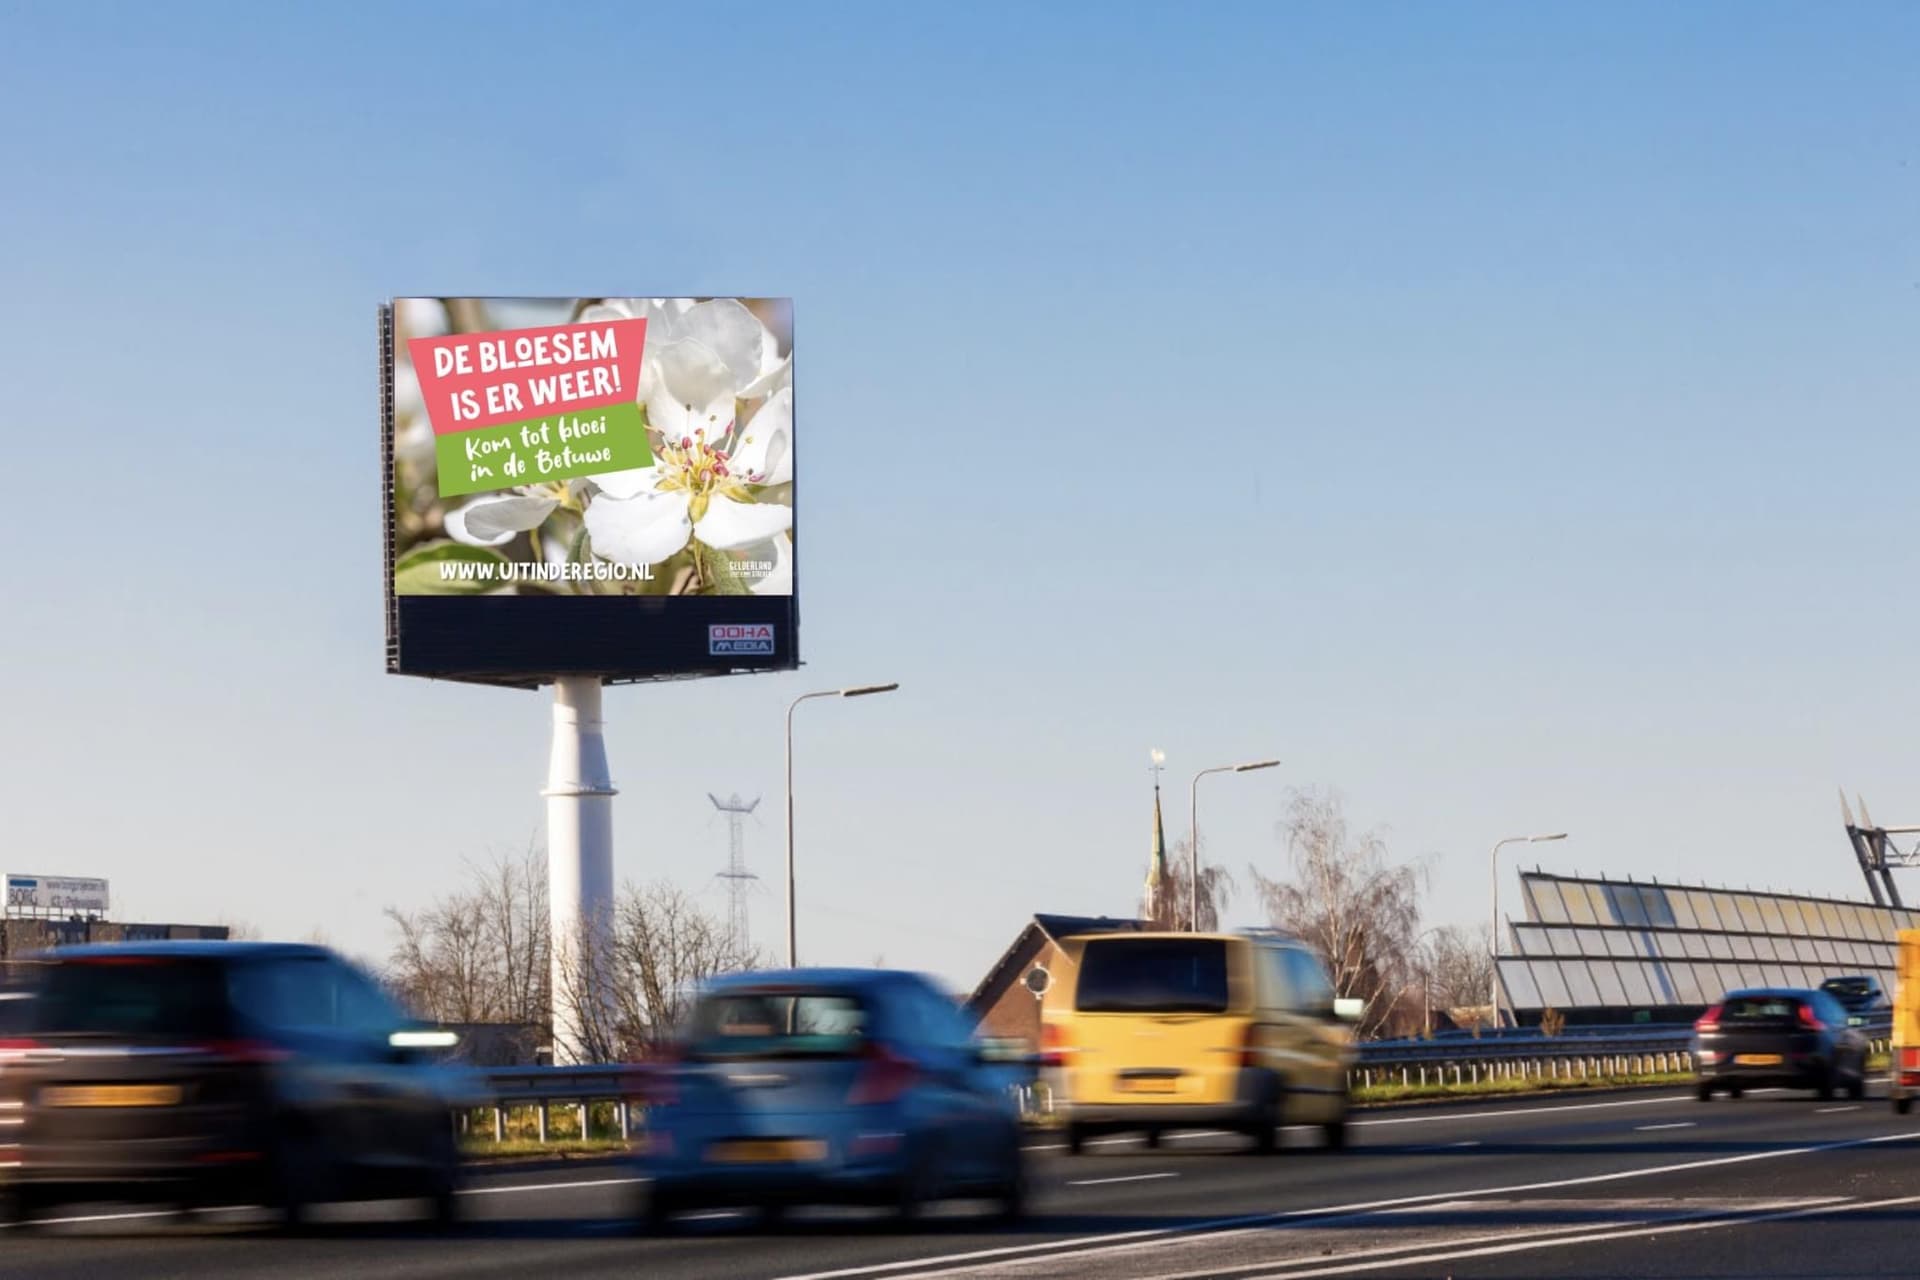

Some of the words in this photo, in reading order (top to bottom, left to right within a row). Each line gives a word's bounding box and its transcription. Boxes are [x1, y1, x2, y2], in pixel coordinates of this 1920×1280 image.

[434, 345, 473, 378] DE
[479, 328, 618, 373] BLOESEM
[451, 389, 480, 421] IS
[486, 383, 524, 414] ER
[528, 365, 622, 406] WEER!
[465, 437, 511, 461] Kom
[520, 422, 550, 447] tot
[558, 416, 606, 443] bloei
[470, 464, 493, 482] in
[503, 452, 526, 478] de
[535, 446, 611, 474] Betuwe
[439, 561, 655, 581] WWW.UITINDEREGIO.NL
[715, 641, 769, 651] MEDIA
